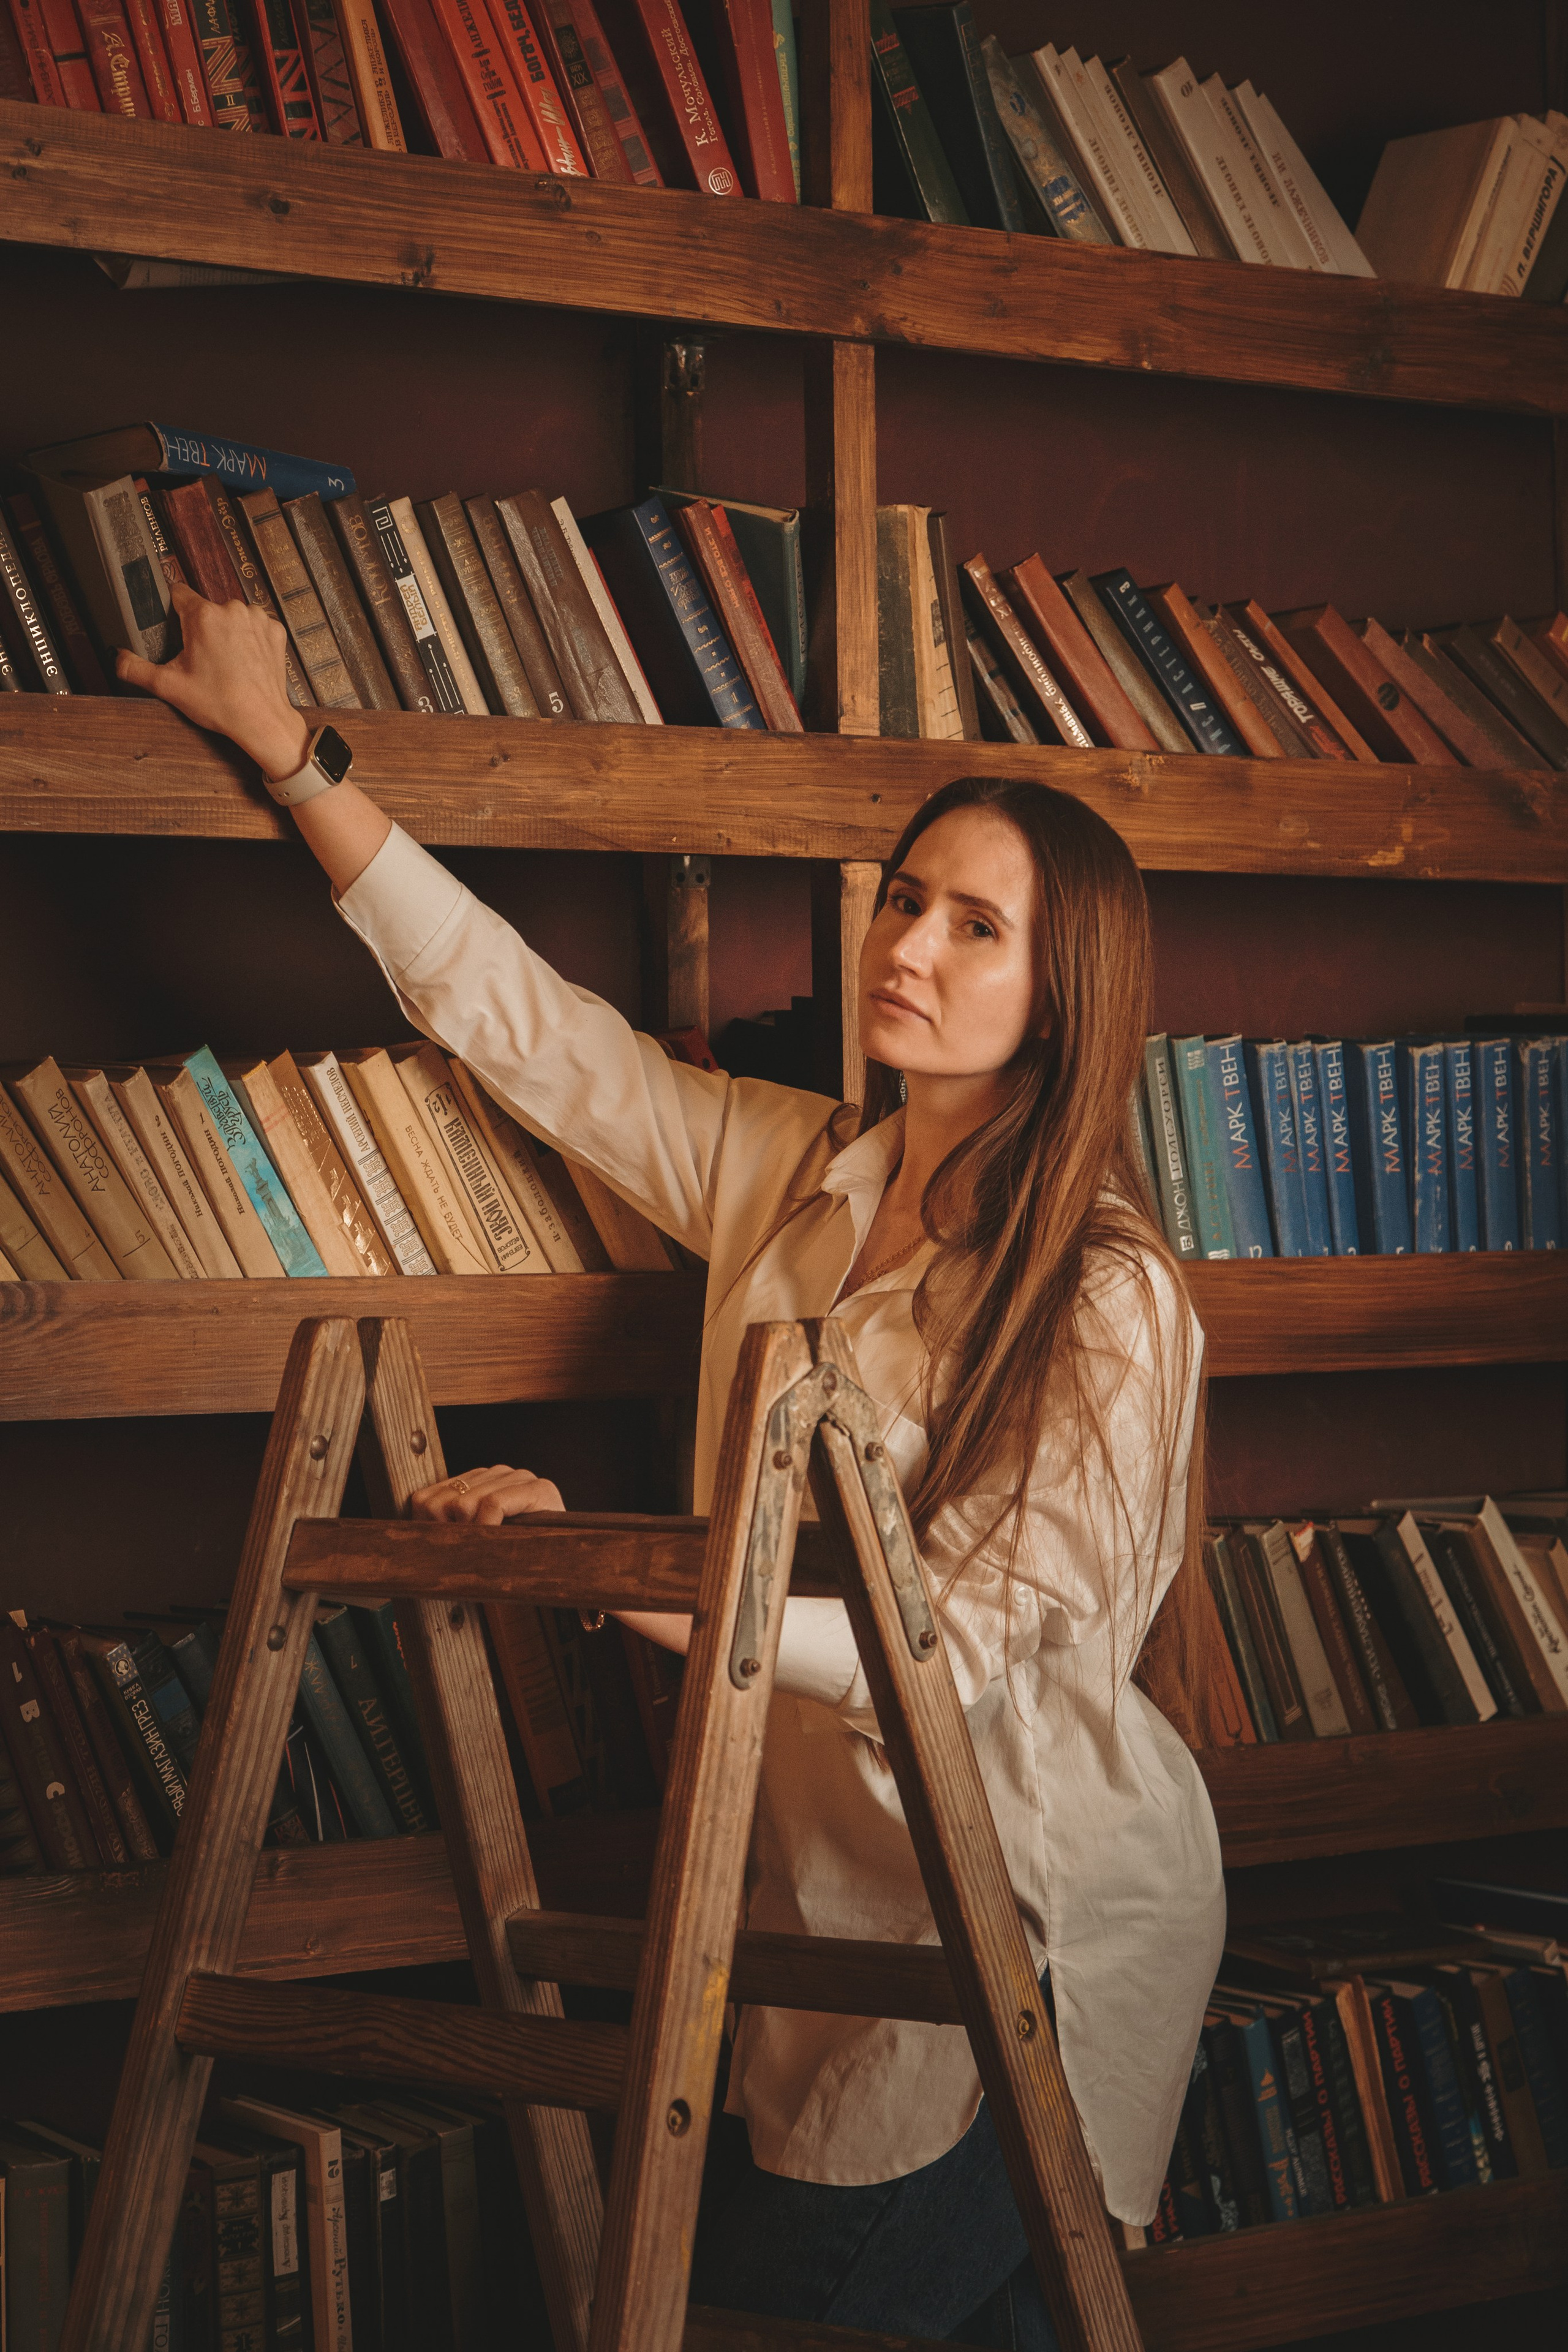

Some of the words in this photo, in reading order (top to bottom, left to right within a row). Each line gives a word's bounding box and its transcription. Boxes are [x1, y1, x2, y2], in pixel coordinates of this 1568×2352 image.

[457, 0, 483, 50] АНЖЕЛИ
[660, 26, 702, 124] Мочульский
[692, 128, 709, 147] К.
[1520, 167, 1559, 260] ВЕРШИГОРА
[157, 433, 214, 467] ТВЕН
[206, 444, 270, 480] МАРК
[139, 495, 169, 553] РЫЛЕНКОВ
[29, 535, 59, 584] ОРЛОВА
[0, 527, 59, 677] ЭНЦИКЛОПЕДИ
[399, 584, 423, 631] АНДРЕЙ
[406, 584, 429, 626] БЕЛЫЙ
[1125, 594, 1207, 715] ПАСТЕРНАК
[547, 690, 565, 714] 5
[1051, 696, 1090, 751] льманах
[1199, 714, 1233, 755] РИС
[324, 1066, 353, 1113] НЕСМЕЛОВ
[1216, 1042, 1242, 1101] ТВЕН
[1271, 1049, 1289, 1103] ТВЕН
[1296, 1049, 1316, 1102] ТВЕН
[1324, 1047, 1345, 1104] ТВЕН
[1374, 1049, 1394, 1104] ТВЕН
[1422, 1051, 1441, 1106] ТВЕН
[1452, 1048, 1472, 1101] ТВЕН
[1492, 1046, 1509, 1101] ТВЕН
[1534, 1049, 1551, 1097] ТВЕН
[53, 1087, 111, 1179] СОФРОНОВ
[152, 1114, 162, 1127] 2
[197, 1075, 247, 1151] Здравствуй
[345, 1113, 371, 1153] АРСЕНИЙ
[1224, 1101, 1252, 1170] МАРК
[1275, 1107, 1297, 1173] МАРК
[1301, 1107, 1322, 1172] МАРК
[1328, 1105, 1352, 1172] МАРК
[1379, 1107, 1401, 1172] МАРК
[1455, 1106, 1475, 1170] МАРК
[1494, 1102, 1512, 1167] МАРК
[1536, 1102, 1554, 1166] МАРК
[46, 1102, 105, 1196] АНАТОЛИЙ
[159, 1131, 186, 1178] ПОГОДИН
[203, 1128, 228, 1175] ПОГОДИН
[1424, 1109, 1444, 1175] МАРК
[181, 1179, 203, 1218] Николай
[224, 1176, 245, 1215] Николай
[404, 1125, 425, 1158] ВЕСНА
[420, 1159, 442, 1194] ЖДАТЬ
[436, 1194, 448, 1209] НЕ
[443, 1211, 464, 1241] БУДЕТ
[1172, 1180, 1193, 1233] ДЖОН
[133, 1229, 146, 1244] 5
[499, 1243, 524, 1262] ЕВГЕНИЙ
[129, 1698, 155, 1730] ГРЕЗ
[141, 1726, 177, 1783] МАГАЗИН
[1300, 2011, 1325, 2086] ПАРТИИ
[1379, 1998, 1407, 2072] ПАРТИИ
[1321, 2108, 1348, 2204] РАССКАЗЫ
[1402, 2094, 1433, 2187] РАССКАЗЫ
